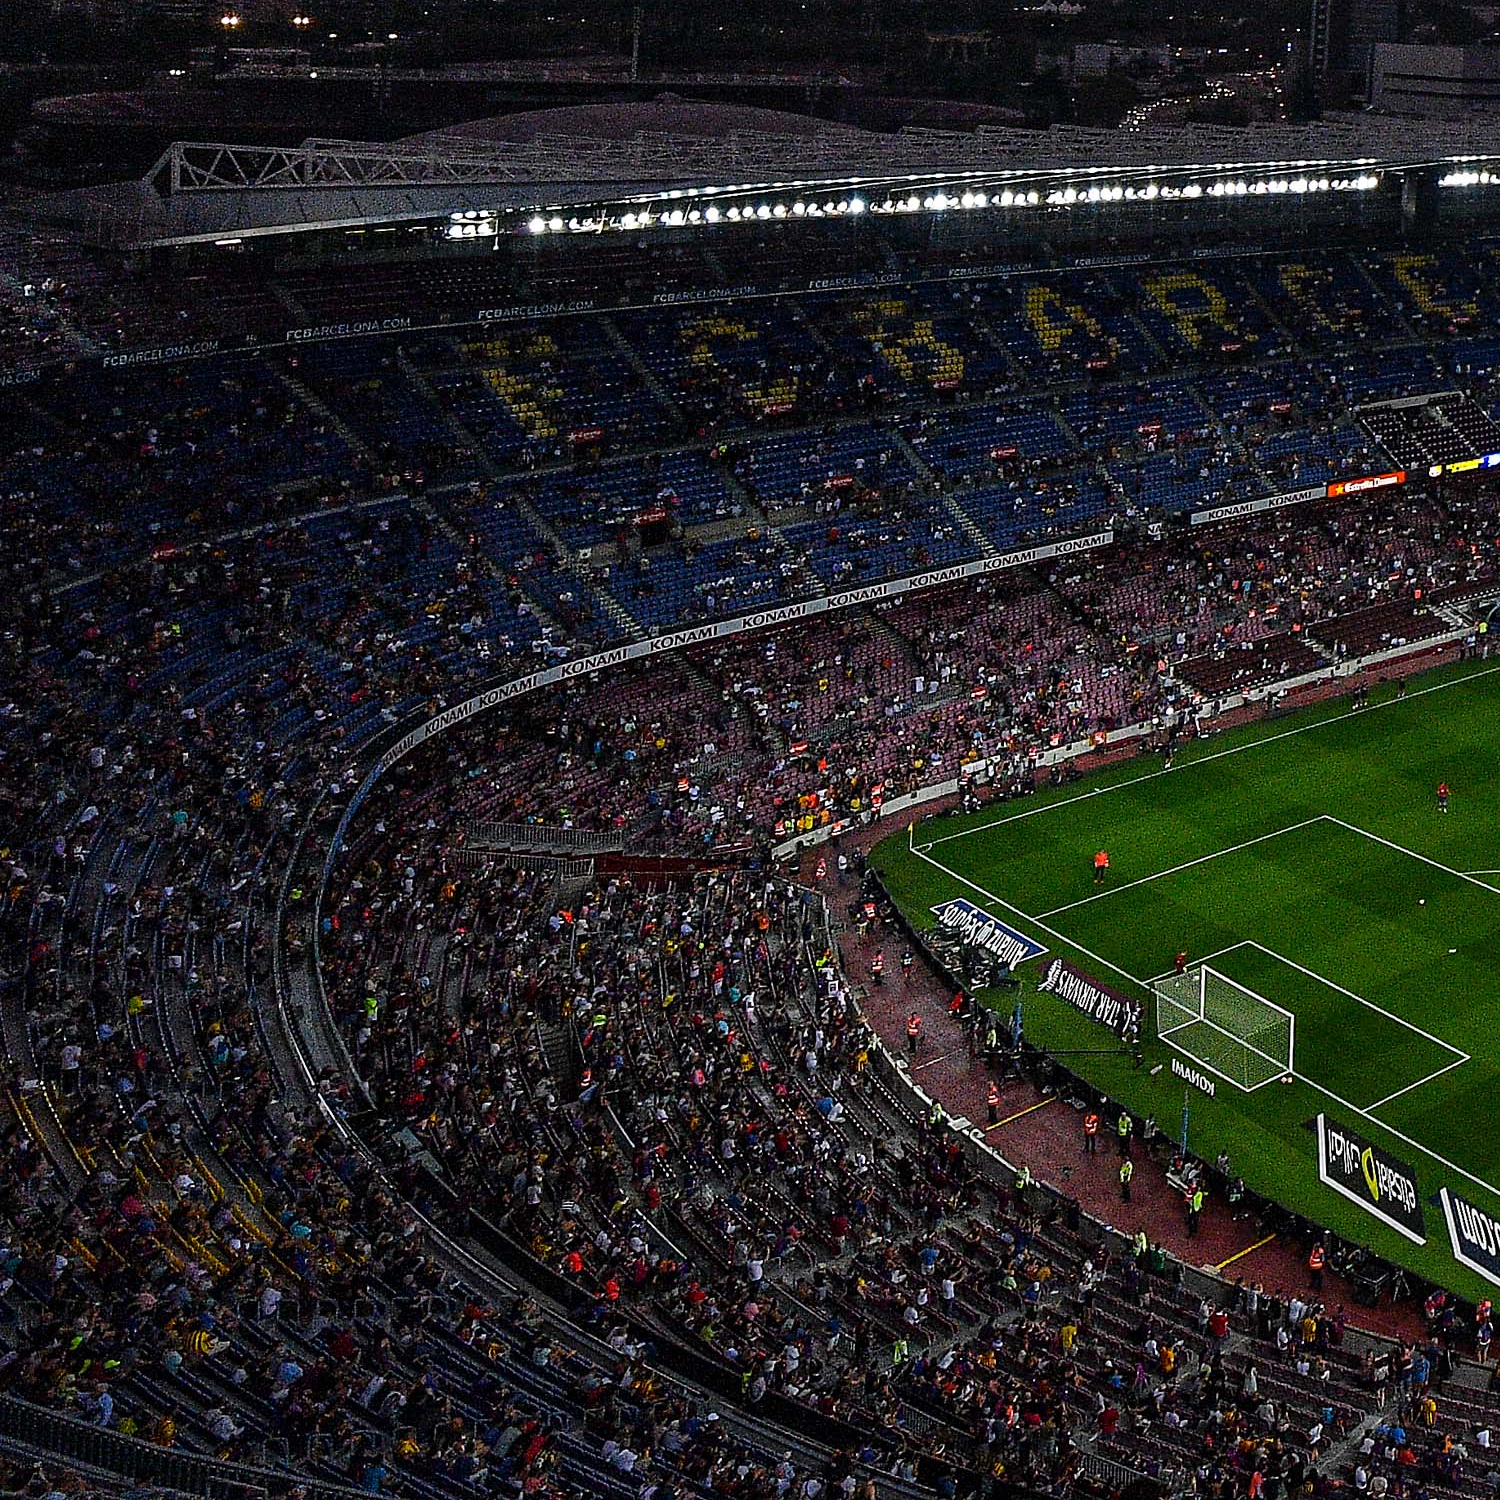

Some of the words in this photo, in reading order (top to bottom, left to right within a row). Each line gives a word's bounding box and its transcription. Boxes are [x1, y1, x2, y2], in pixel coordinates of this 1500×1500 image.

[478, 301, 594, 320] FCBARCELONA.COM
[286, 317, 411, 341] FCBARCELONA.COM
[103, 340, 219, 368] FCBARCELONA.COM
[1268, 490, 1312, 508] KONAMI
[1344, 480, 1374, 493] Estrella
[1208, 503, 1253, 520] KONAMI
[1054, 533, 1106, 555] KONAMI
[982, 550, 1036, 571] KONAMI
[909, 567, 966, 589] KONAMI
[827, 585, 889, 609] KONAMI
[741, 605, 807, 630] KONAMI
[650, 625, 718, 652] KONAMI
[560, 649, 628, 678] KONAMI
[479, 675, 538, 709] KONAMI
[424, 702, 474, 737] KONAMI
[939, 904, 983, 945] Seguros
[985, 928, 1029, 971] Allianz
[1055, 970, 1101, 1013] AIRWAYS
[1172, 1058, 1216, 1097] KONAMI
[1376, 1160, 1416, 1213] etisalat
